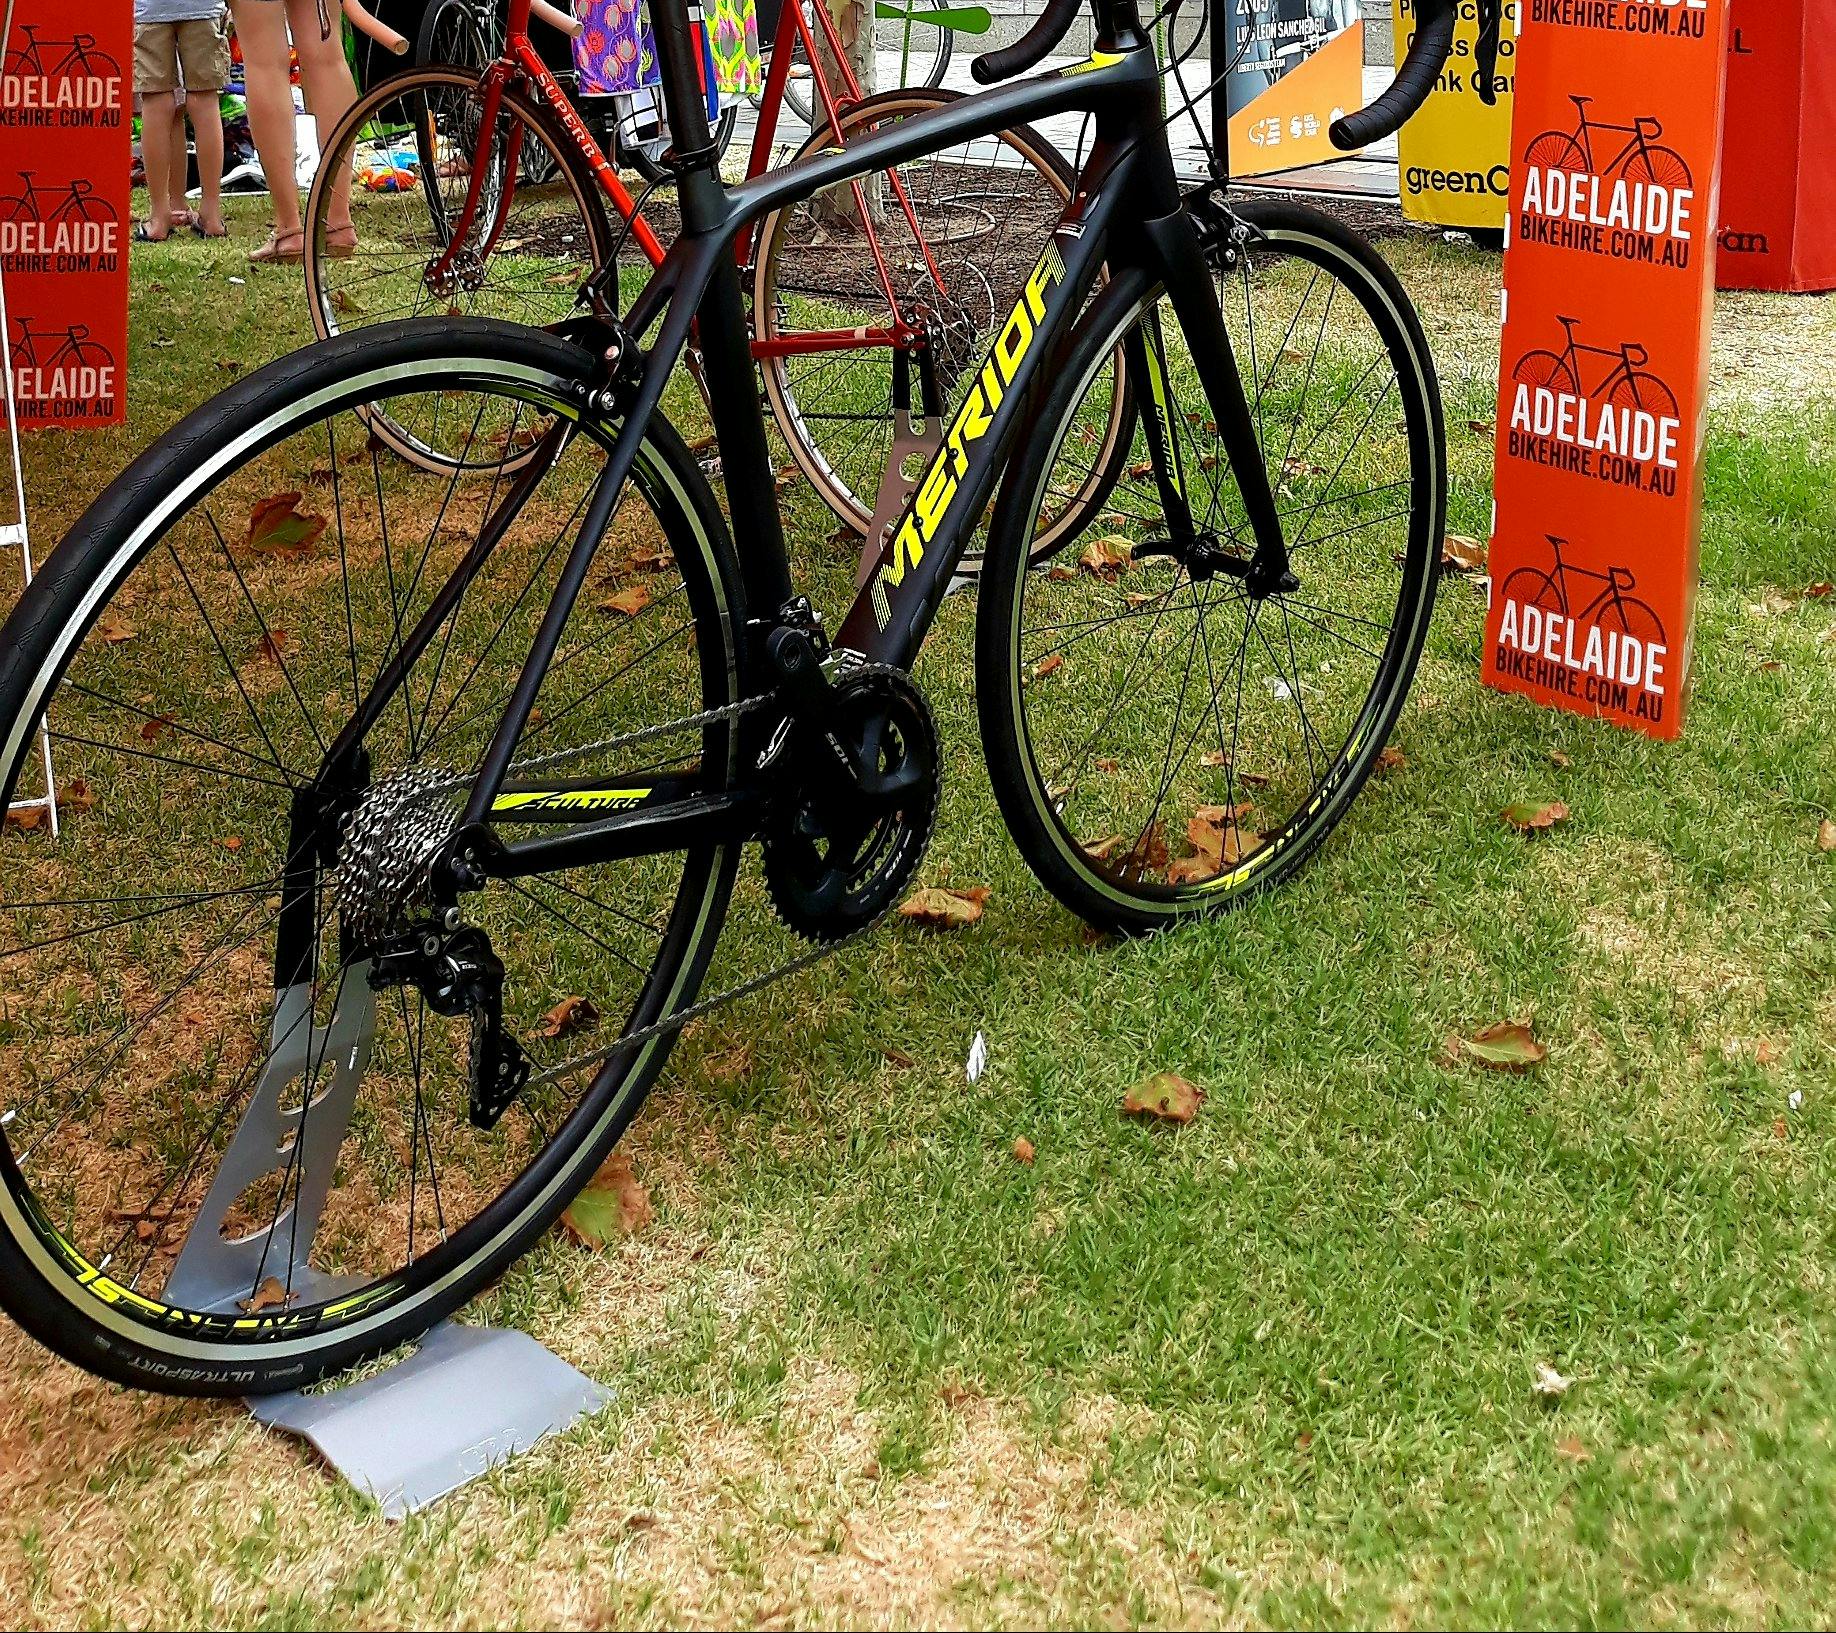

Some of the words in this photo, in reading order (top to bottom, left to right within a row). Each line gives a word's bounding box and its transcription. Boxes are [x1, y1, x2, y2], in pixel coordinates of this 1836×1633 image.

[1256, 22, 1277, 41] LEON
[2, 76, 122, 109] DELAIDE
[536, 72, 597, 158] SUPERB
[1, 220, 119, 254] DELAIDE
[1520, 165, 1695, 240] ADELAIDE
[1519, 213, 1690, 269] BIKEHIRE.COM.AU
[870, 237, 1067, 634] MERIDA
[1509, 382, 1681, 469] ADELAIDE
[1507, 430, 1677, 498] BIKEHIRE.COM.AU
[1495, 644, 1664, 724] BIKEHIRE.COM.AU
[1498, 599, 1668, 695] ADELAIDE
